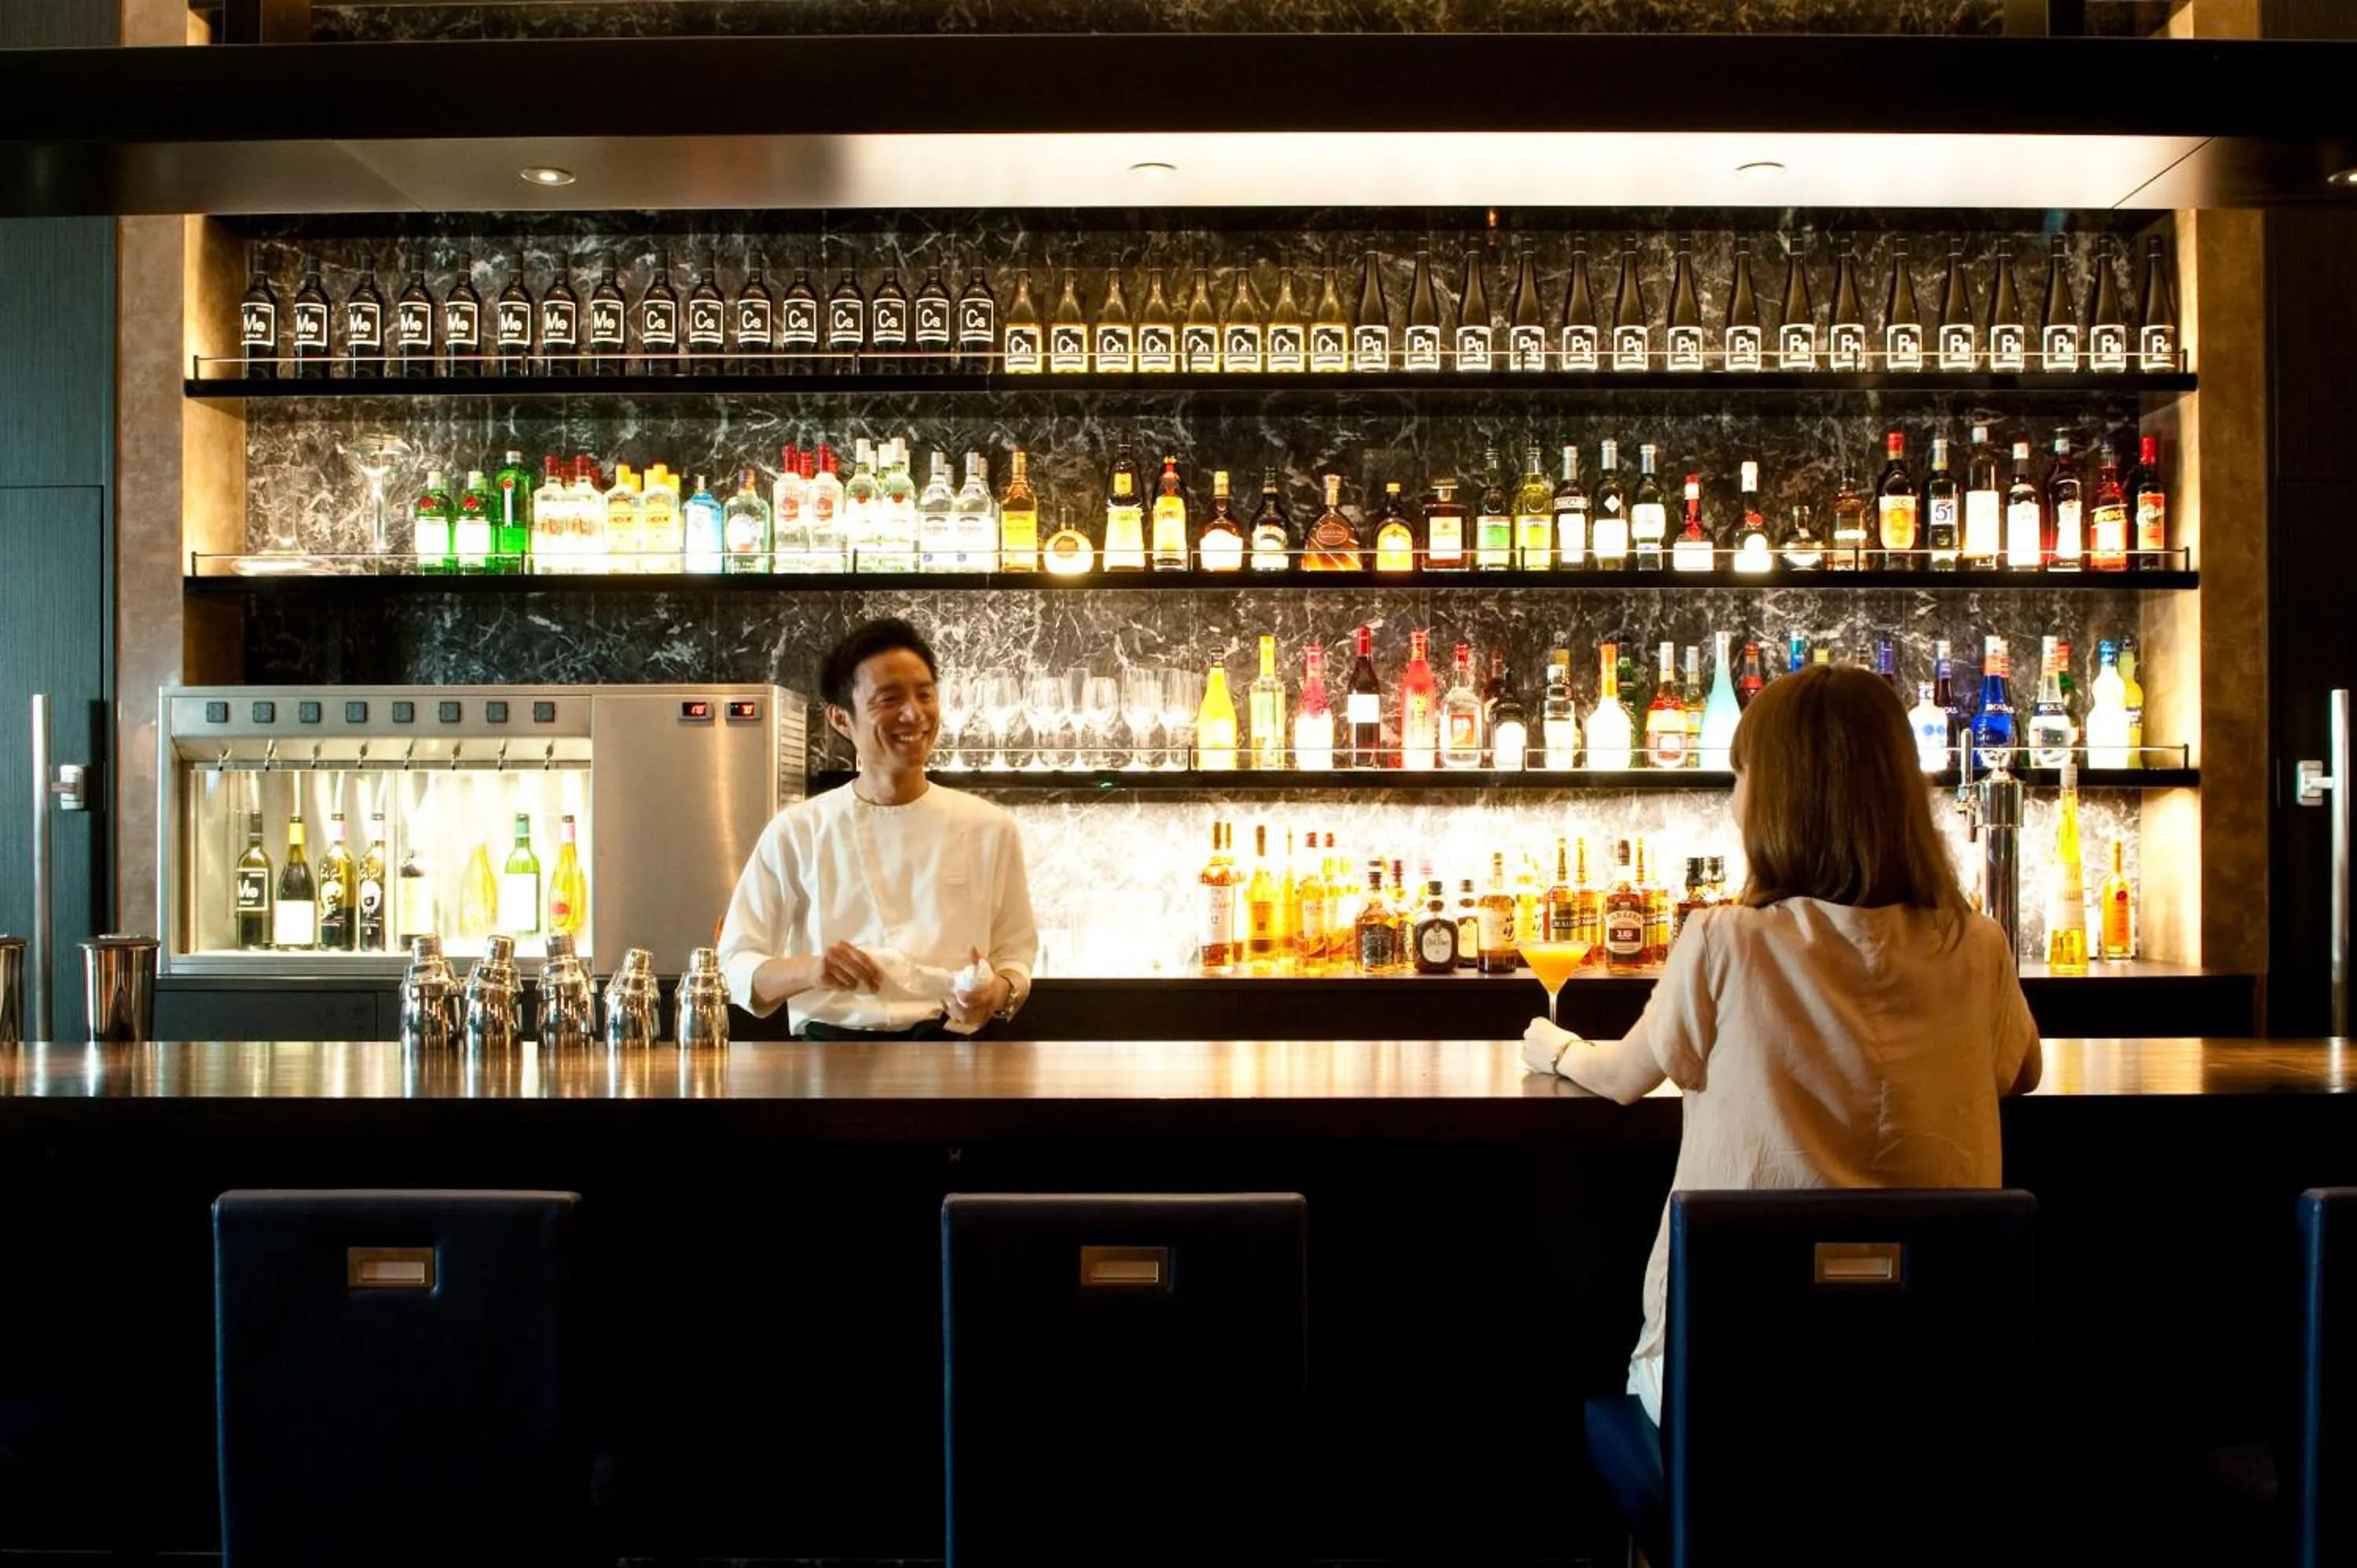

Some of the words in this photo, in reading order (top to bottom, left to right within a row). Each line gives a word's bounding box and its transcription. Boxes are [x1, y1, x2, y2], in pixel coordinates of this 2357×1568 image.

[243, 313, 267, 332] Me
[295, 313, 319, 332] Me
[349, 312, 372, 332] Me
[400, 312, 423, 332] Me
[447, 312, 470, 332] Me
[499, 312, 523, 332] Me
[544, 311, 568, 331] Me
[592, 310, 617, 330] Me
[646, 310, 666, 331] Cs
[694, 310, 716, 331] Cs
[741, 310, 762, 331] Cs
[787, 309, 809, 329] Cs
[834, 309, 856, 330] Cs
[878, 309, 899, 329] Cs
[919, 309, 942, 329] Cs
[966, 308, 986, 328] Cs
[1935, 504, 1954, 522] 51
